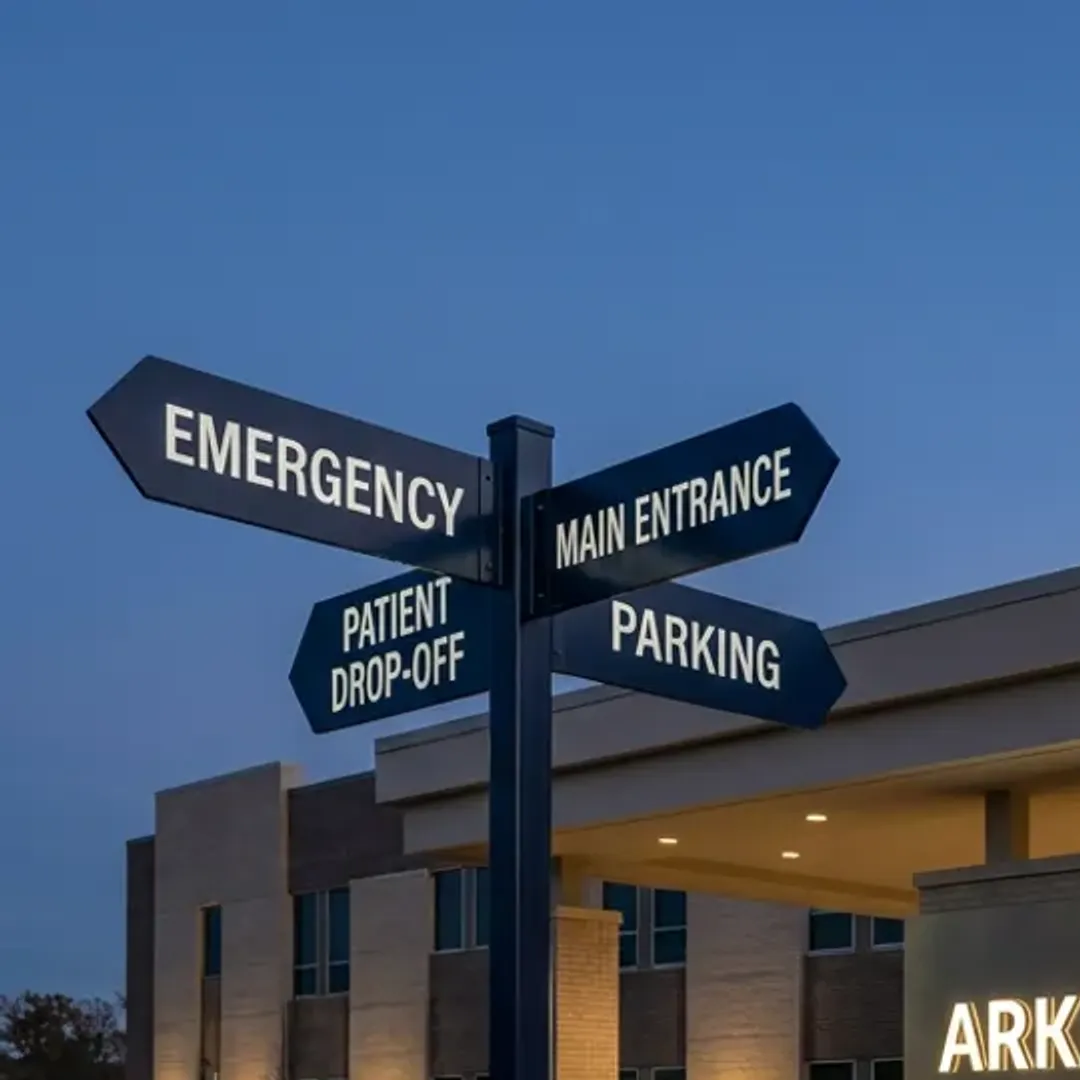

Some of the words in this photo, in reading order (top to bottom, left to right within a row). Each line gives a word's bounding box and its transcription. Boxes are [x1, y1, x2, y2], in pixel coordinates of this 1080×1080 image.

[165, 403, 465, 537] EMERGENCY
[556, 503, 625, 570] MAIN
[635, 447, 792, 545] ENTRANCE
[343, 576, 452, 652] PATIENT
[612, 600, 780, 690] PARKING
[331, 631, 465, 713] DROP-OFF
